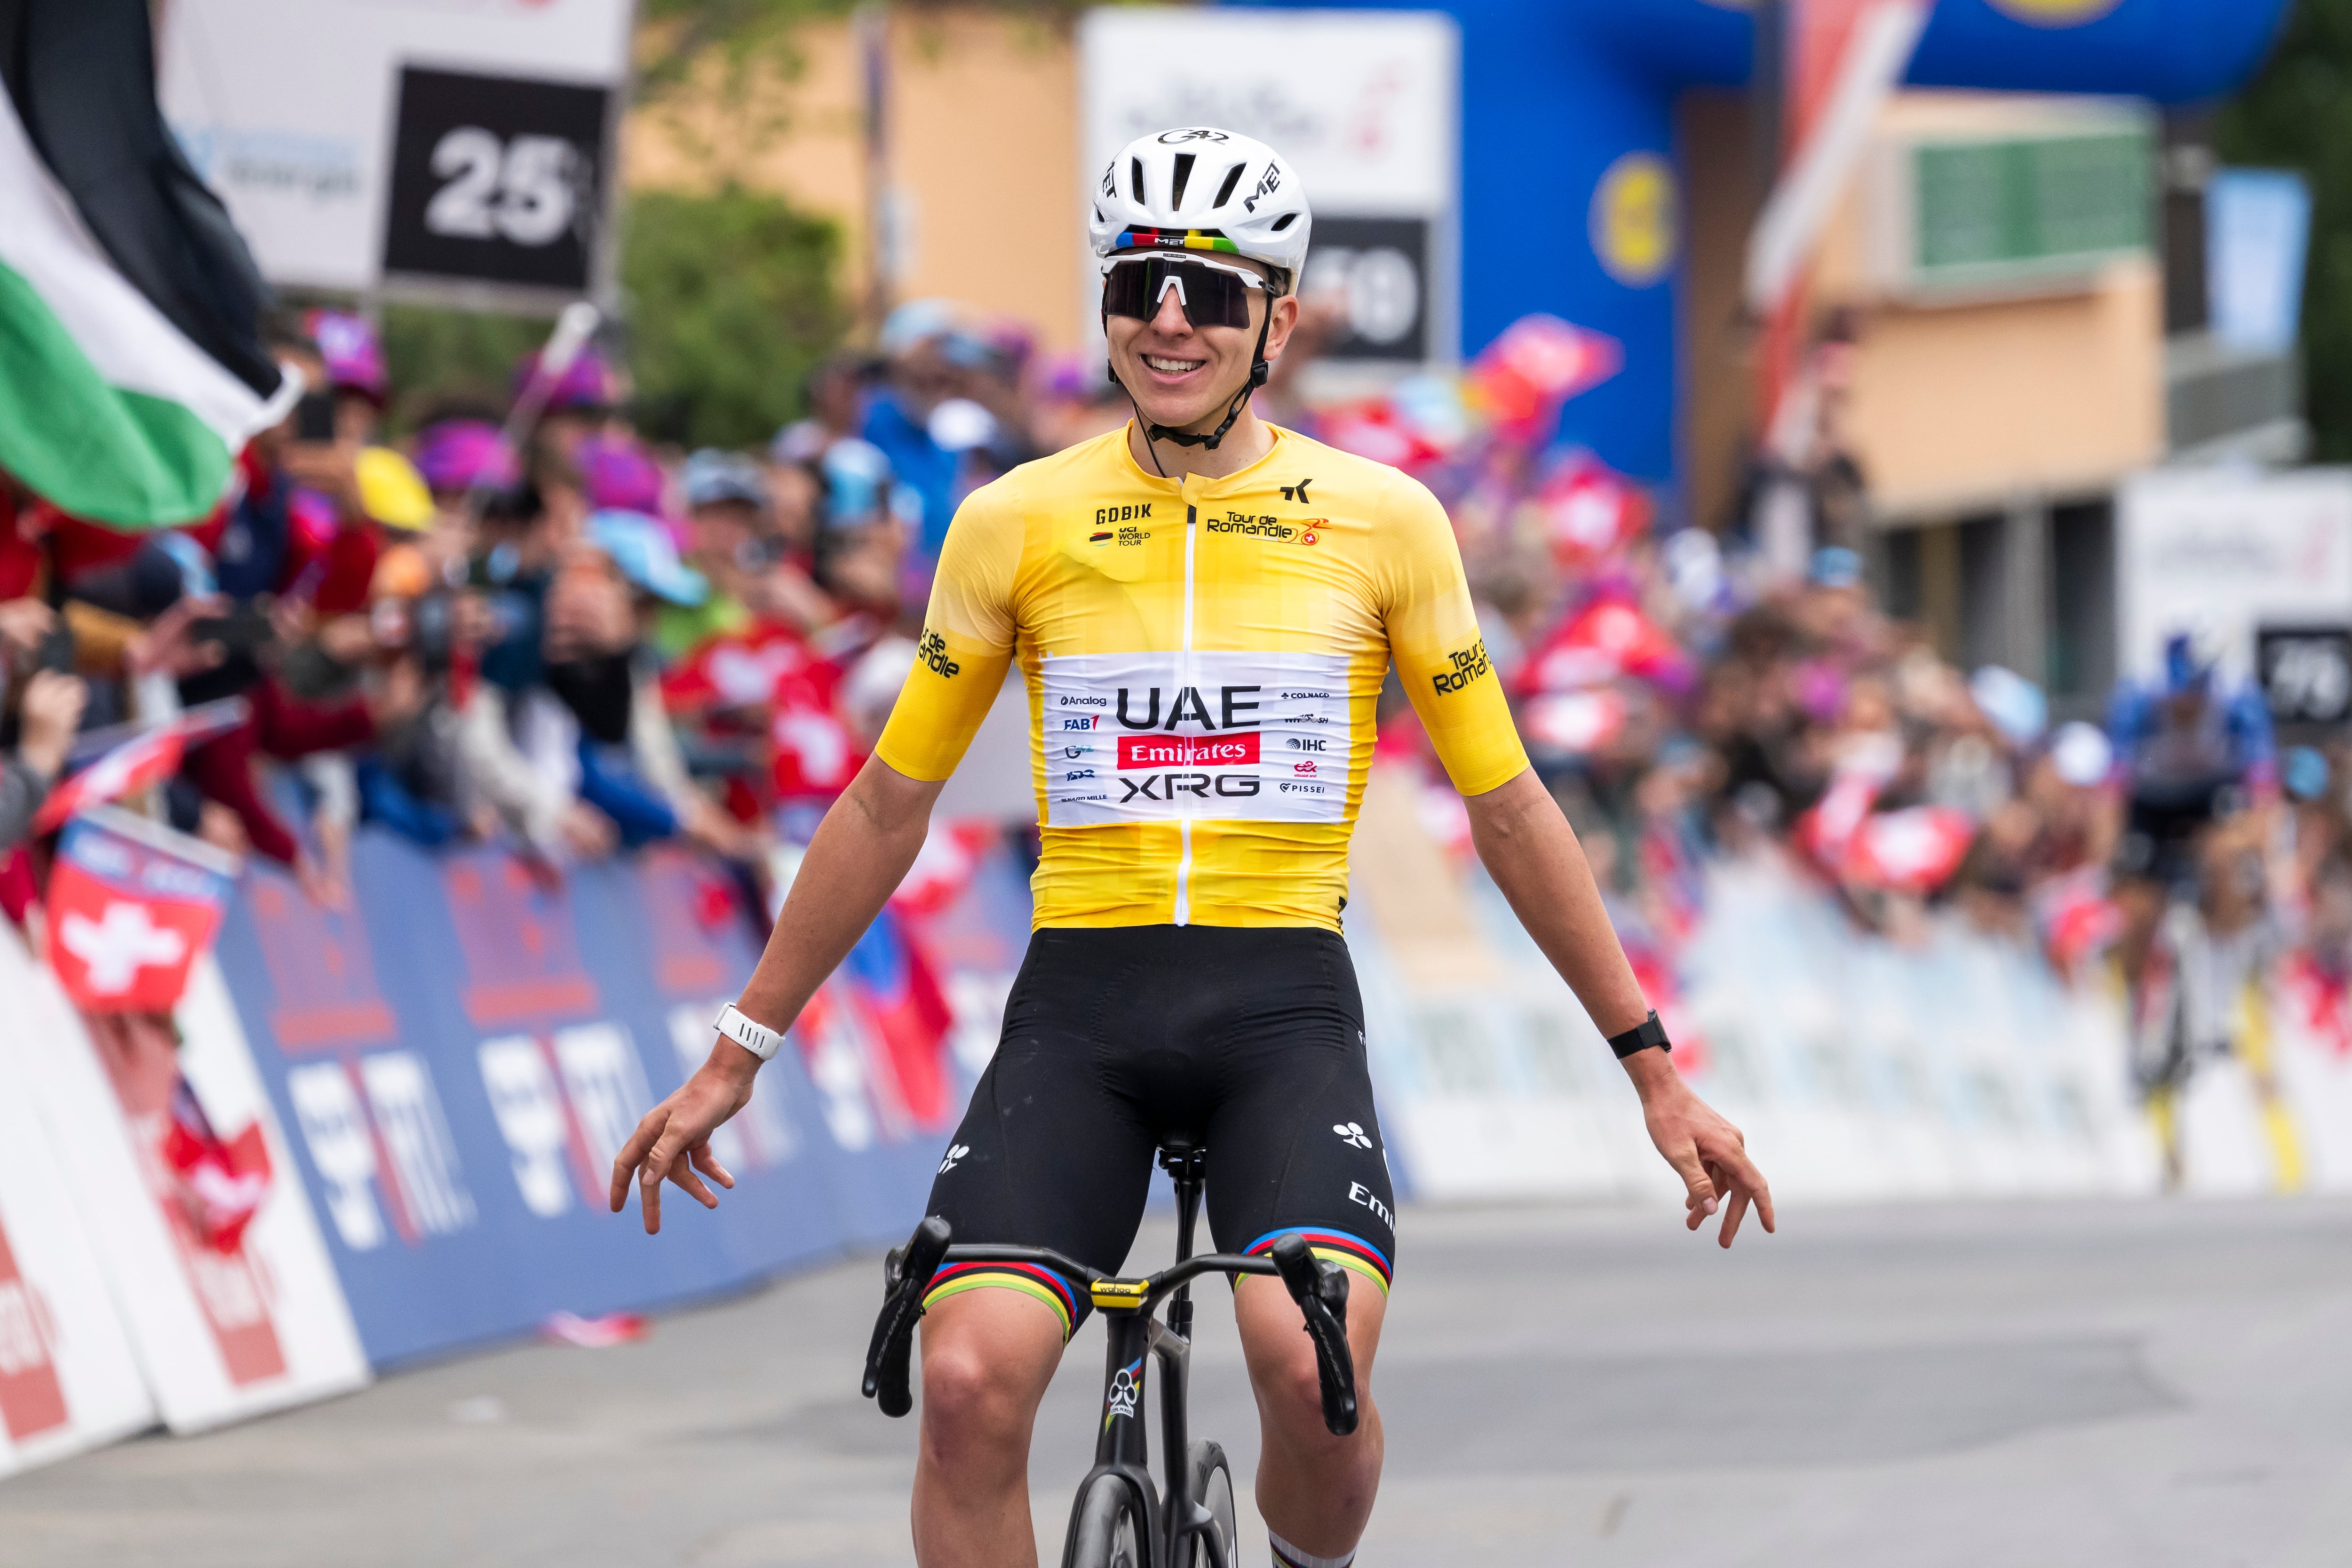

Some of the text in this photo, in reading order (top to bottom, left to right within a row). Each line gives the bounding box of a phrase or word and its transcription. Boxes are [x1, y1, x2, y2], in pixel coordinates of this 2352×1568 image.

[1244, 159, 1280, 214] MET
[1096, 503, 1152, 525] GOBIK
[1226, 511, 1277, 525] Tour de
[929, 633, 946, 653] de
[1448, 643, 1478, 670] Tour
[1432, 653, 1492, 696] Roman
[1069, 696, 1106, 707] Analog
[1116, 685, 1261, 731] UAE
[1131, 743, 1247, 762] Emirates
[1303, 739, 1327, 751] IHC
[1118, 774, 1261, 803] XRG
[1349, 1181, 1396, 1239] Emi
[1111, 1407, 1132, 1416] COLNAGO
